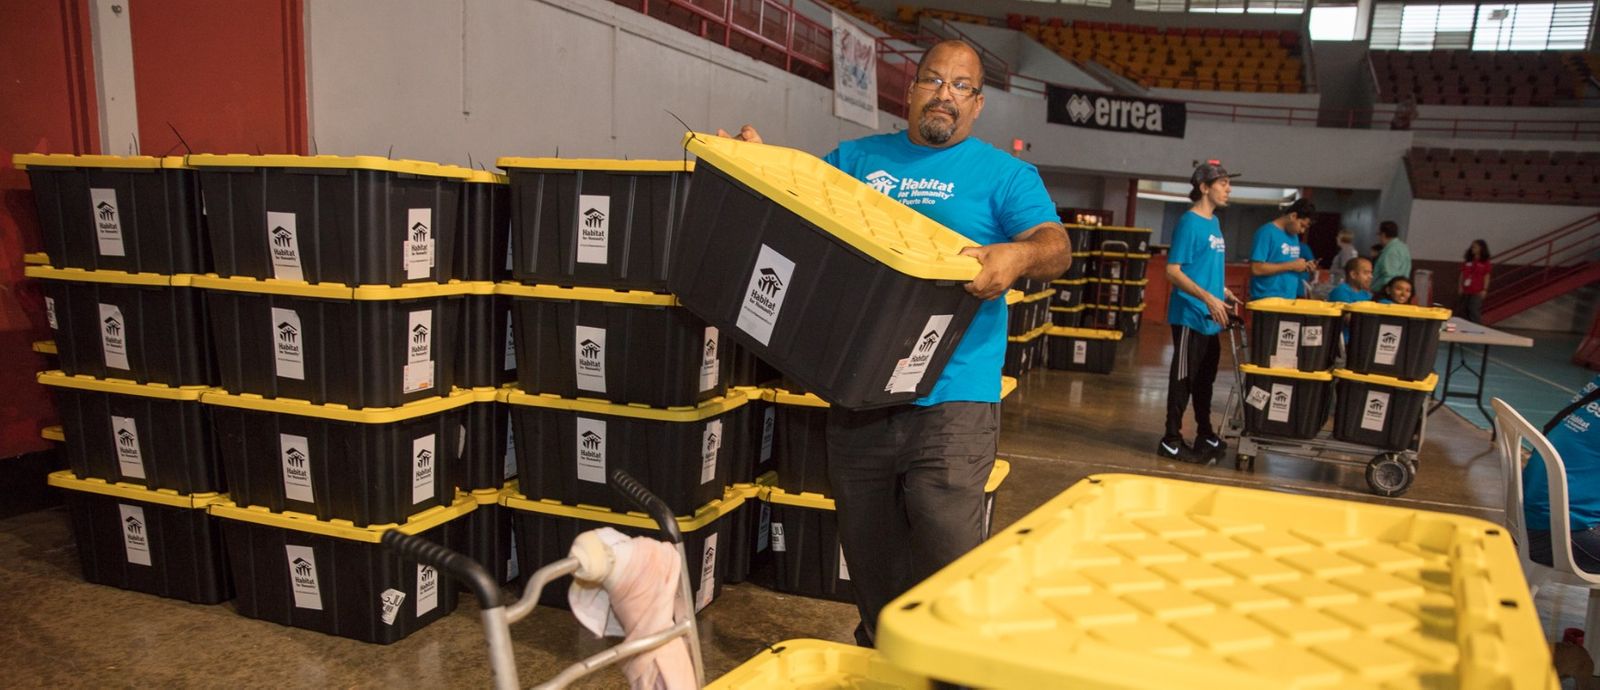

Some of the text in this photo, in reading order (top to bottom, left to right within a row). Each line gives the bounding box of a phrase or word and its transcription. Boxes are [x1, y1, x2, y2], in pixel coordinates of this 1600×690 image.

[1096, 97, 1162, 132] errea
[900, 178, 955, 193] Habitat
[911, 190, 949, 201] Humanity
[583, 229, 604, 237] Habitat
[274, 248, 296, 257] Habitat
[751, 289, 776, 312] Habitat
[278, 343, 299, 352] Habitat
[579, 359, 601, 368] Habitat
[580, 449, 601, 459] Habitat
[286, 467, 307, 476] Habitat
